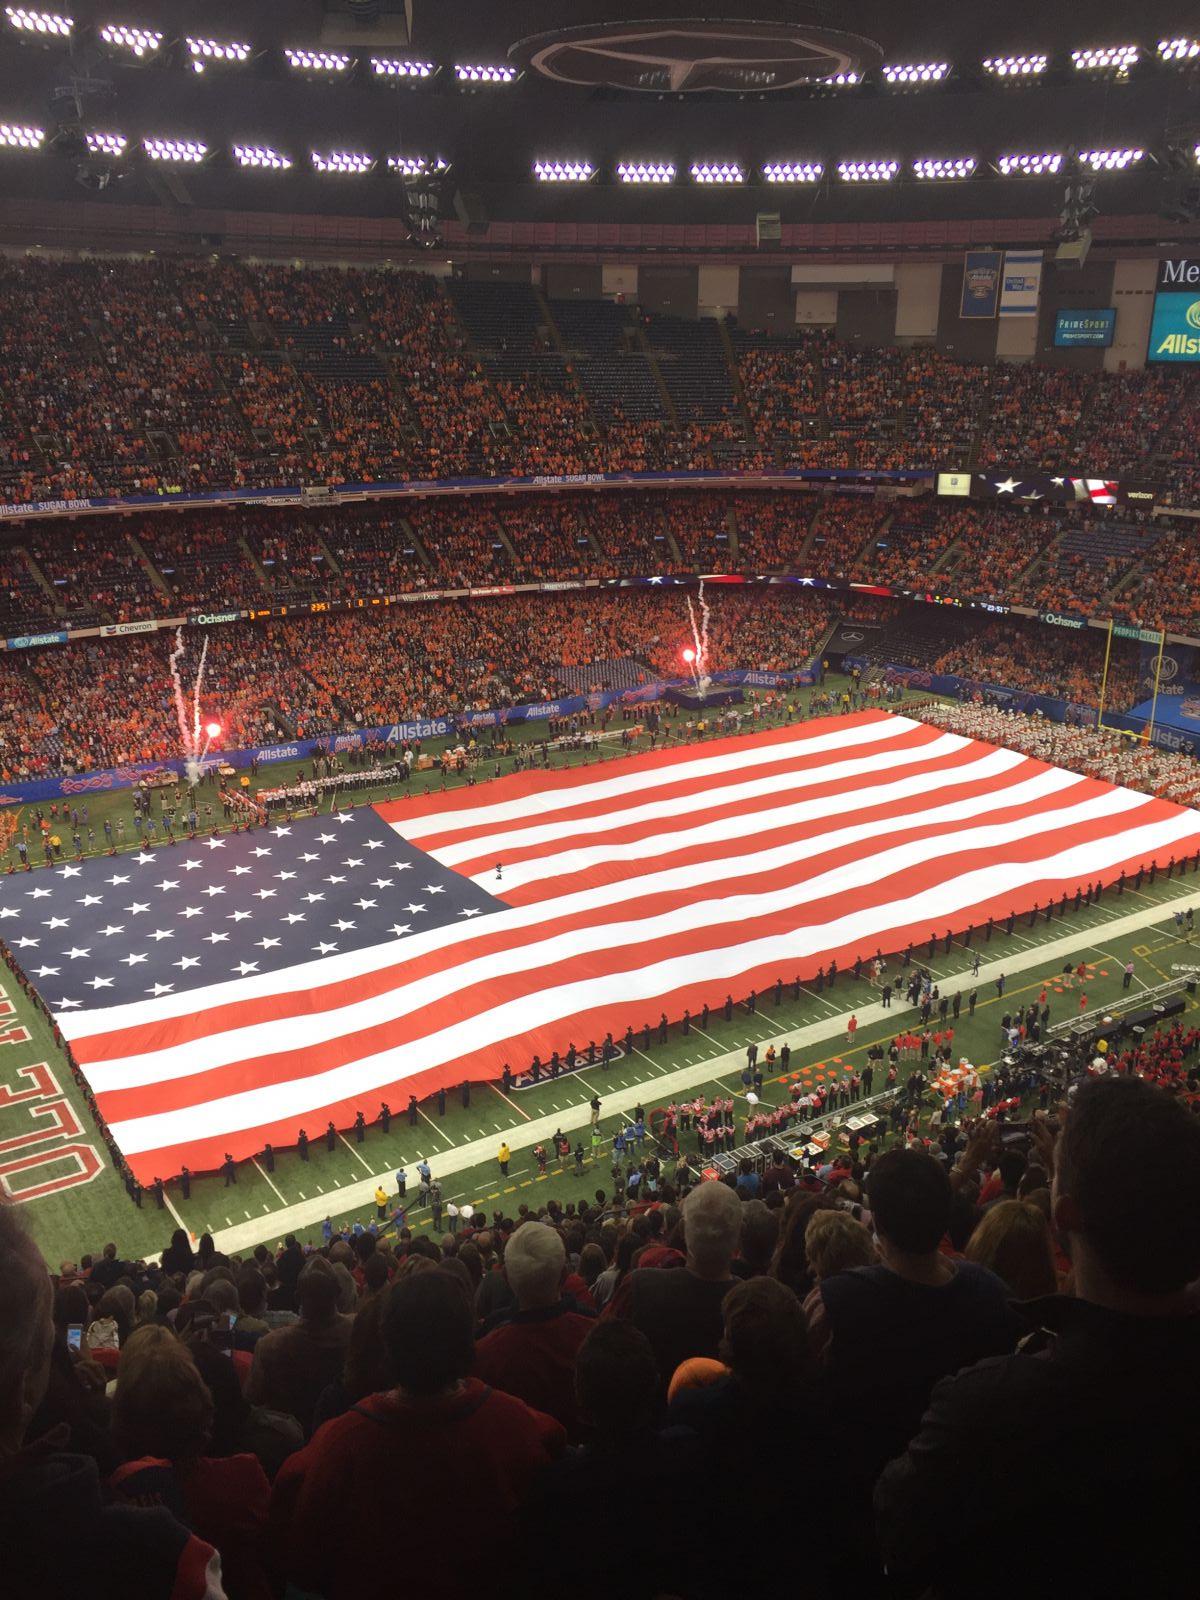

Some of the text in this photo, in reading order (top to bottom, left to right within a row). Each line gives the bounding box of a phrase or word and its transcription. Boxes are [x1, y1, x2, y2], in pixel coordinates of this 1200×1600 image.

[1156, 334, 1200, 354] Alls
[533, 476, 563, 484] Allstate
[565, 474, 587, 483] SUGAR
[1128, 492, 1153, 500] verizon
[0, 498, 92, 515] llstate SUGAR BOWL
[197, 613, 237, 625] Ochsner
[1045, 613, 1084, 630] Ochsner
[119, 622, 152, 633] Chevron
[29, 634, 60, 647] Allstate
[526, 704, 559, 717] Allstate
[386, 720, 448, 742] Allstate
[335, 734, 361, 745] Allstate
[256, 746, 298, 761] Allstate
